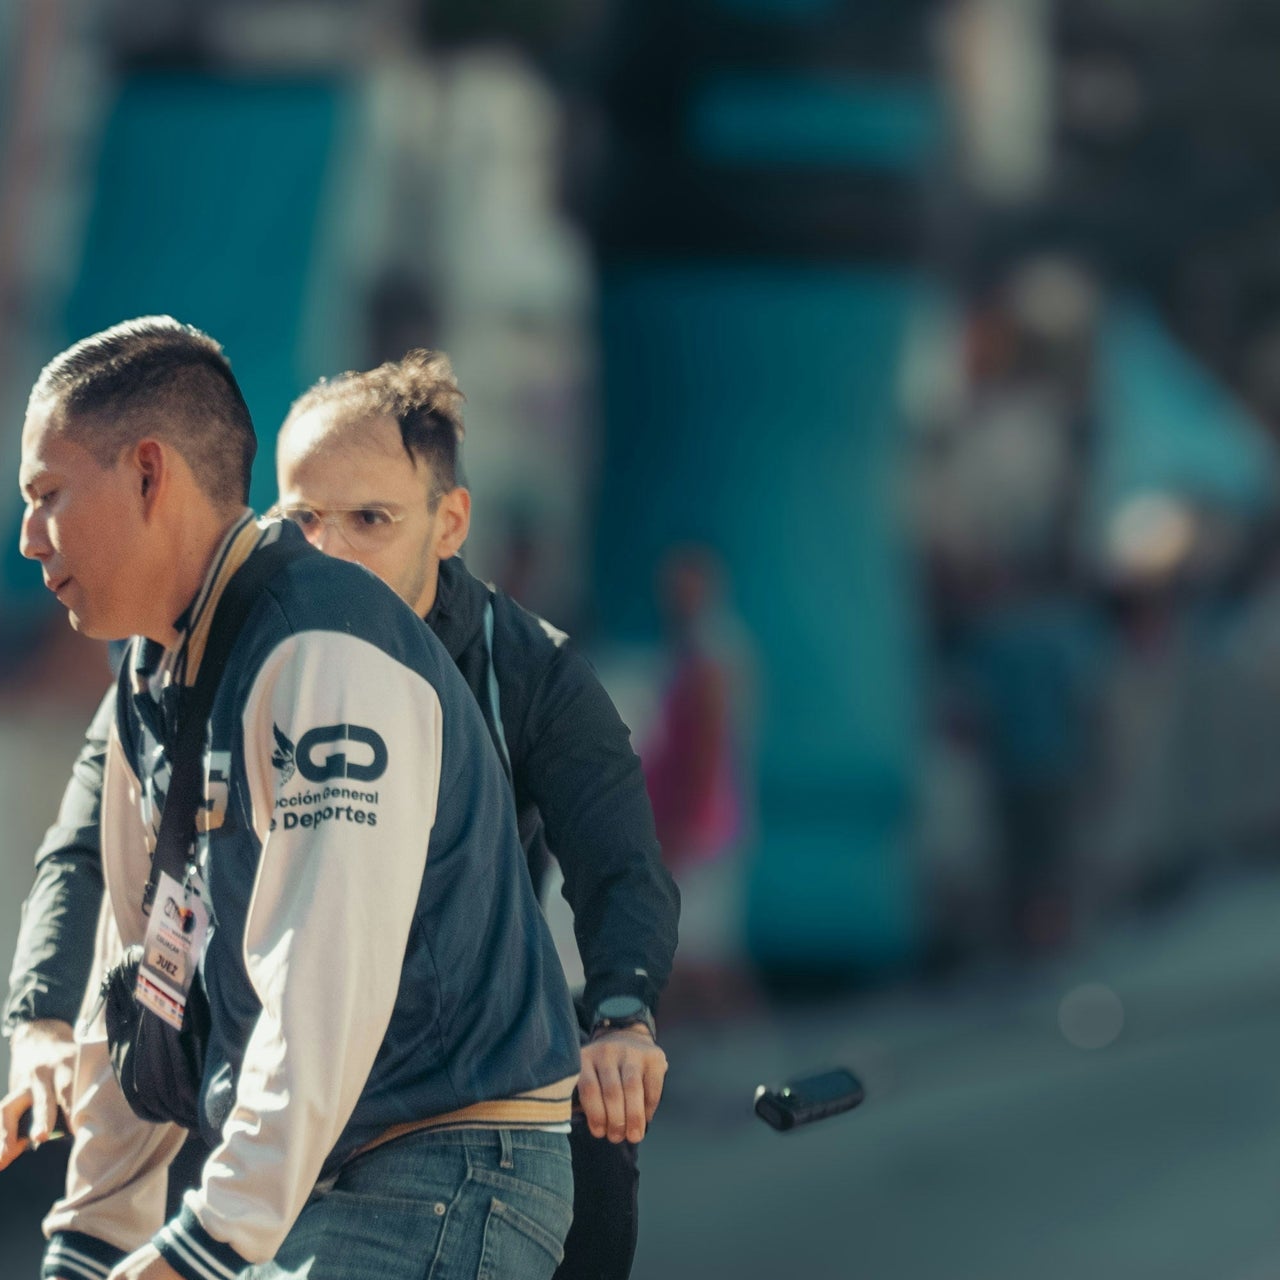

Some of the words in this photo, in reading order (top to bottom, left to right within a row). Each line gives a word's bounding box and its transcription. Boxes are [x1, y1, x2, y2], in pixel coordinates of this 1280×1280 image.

[322, 786, 379, 805] General
[283, 804, 378, 831] Deportes
[155, 954, 179, 977] JUEZ
